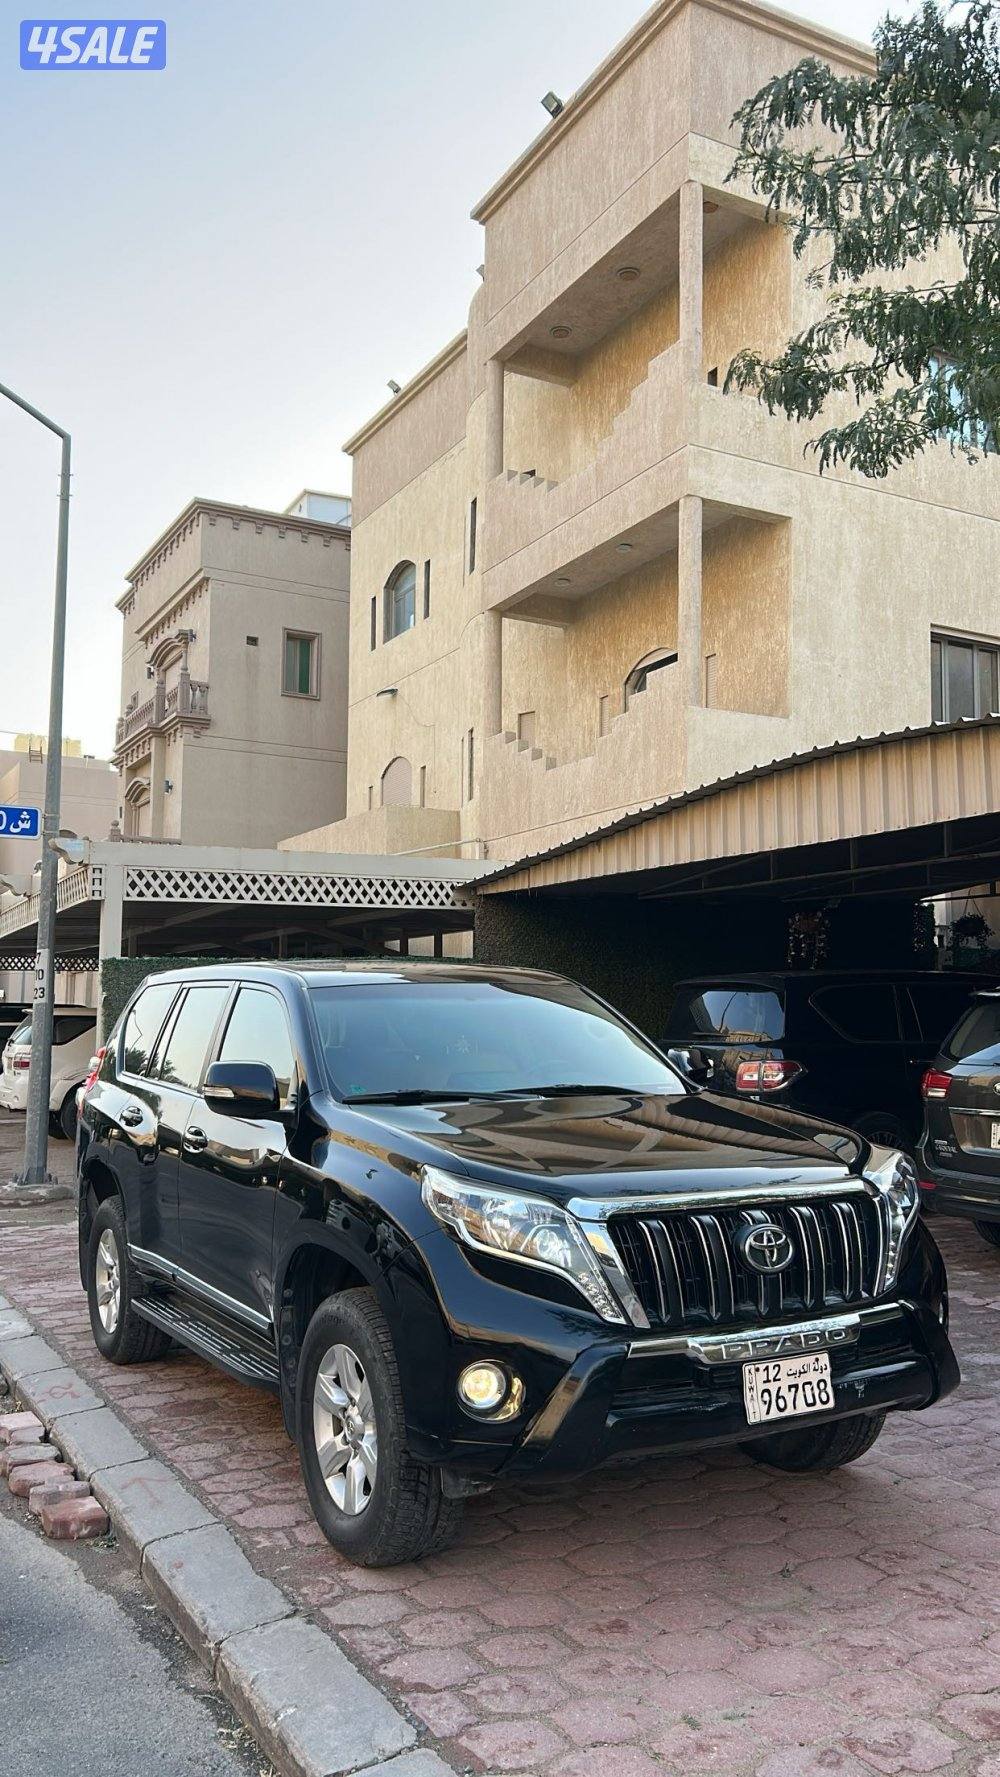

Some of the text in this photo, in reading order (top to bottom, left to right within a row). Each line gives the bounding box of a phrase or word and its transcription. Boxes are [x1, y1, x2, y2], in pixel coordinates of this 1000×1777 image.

[9, 811, 31, 833] ش
[33, 987, 45, 999] 23
[721, 1327, 846, 1359] PRADO
[762, 1363, 782, 1384] 12
[786, 1360, 828, 1379] دولة الكويت
[760, 1378, 830, 1415] 96708
